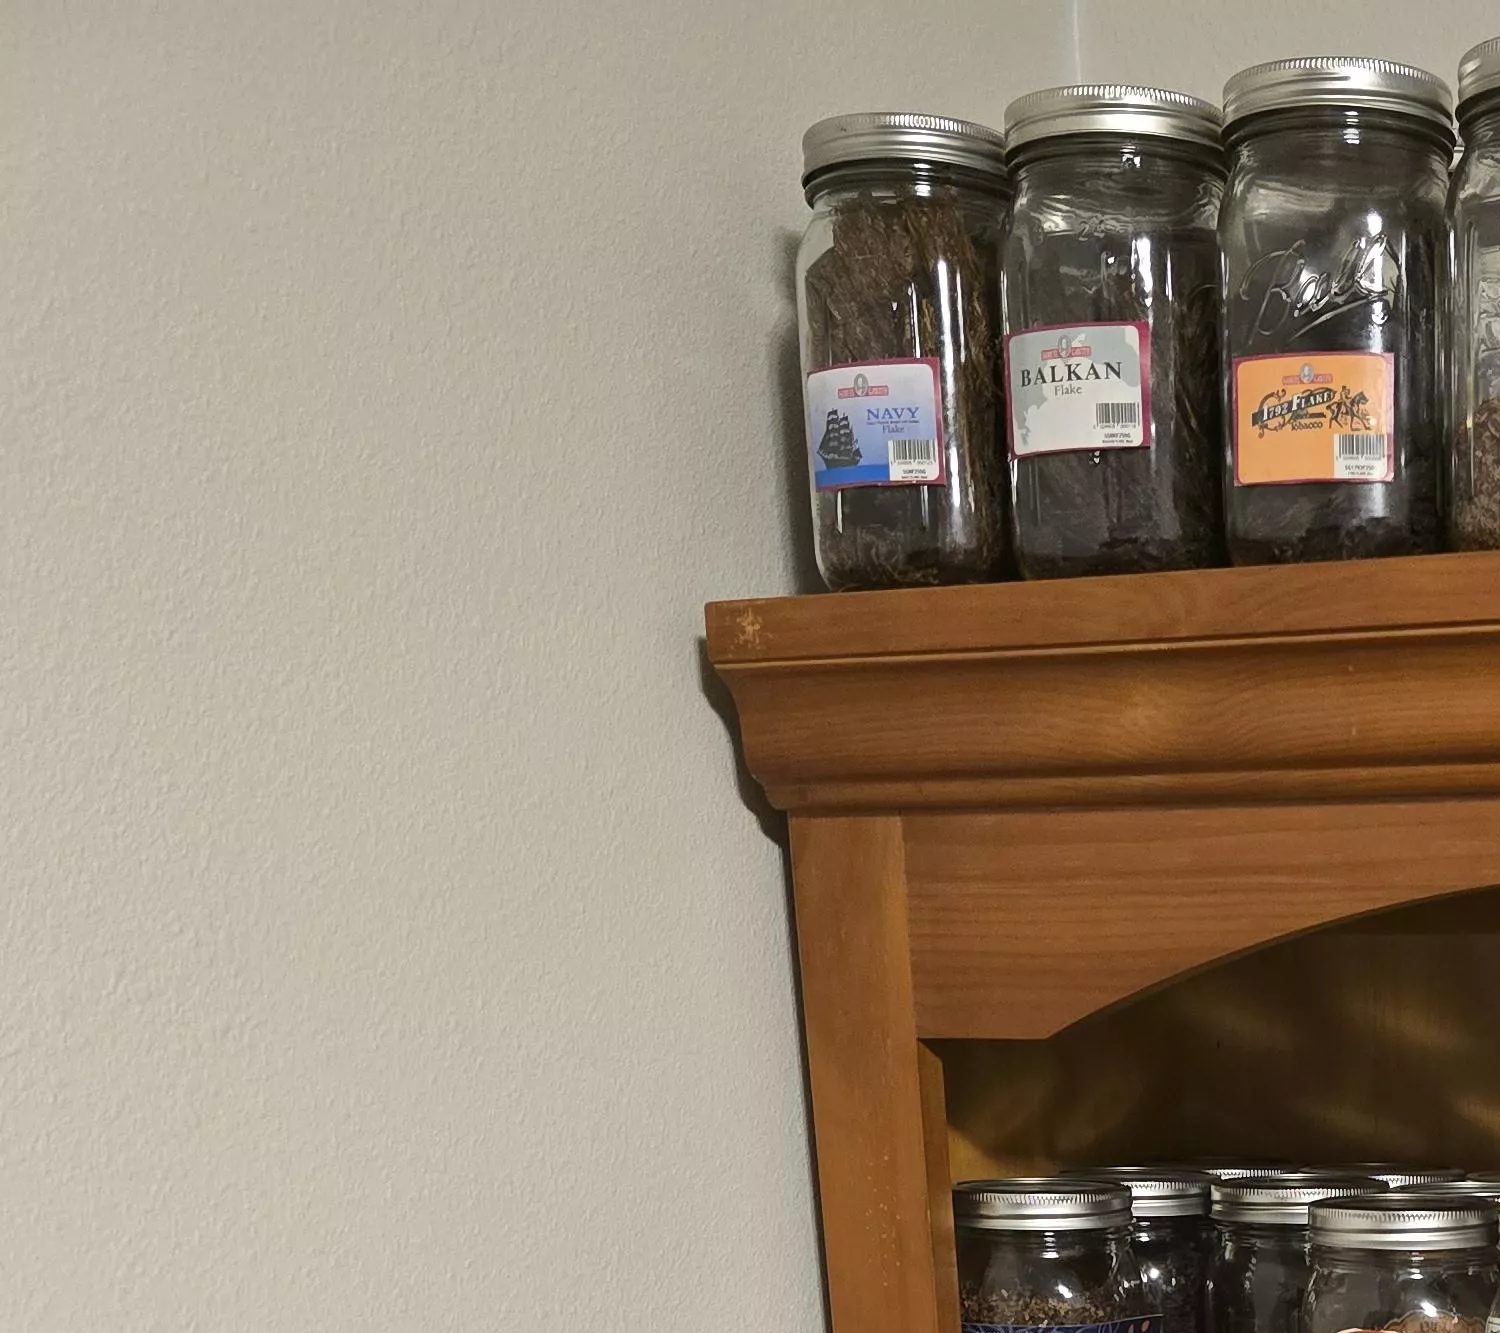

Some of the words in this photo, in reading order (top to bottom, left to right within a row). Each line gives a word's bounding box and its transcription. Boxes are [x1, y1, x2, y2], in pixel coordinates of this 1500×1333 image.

[1021, 362, 1122, 387] BALKAN
[1055, 385, 1083, 396] Flake
[1262, 404, 1288, 420] 1792
[1292, 390, 1333, 411] FLAKE
[867, 407, 920, 420] NAVY
[883, 425, 905, 434] Flake
